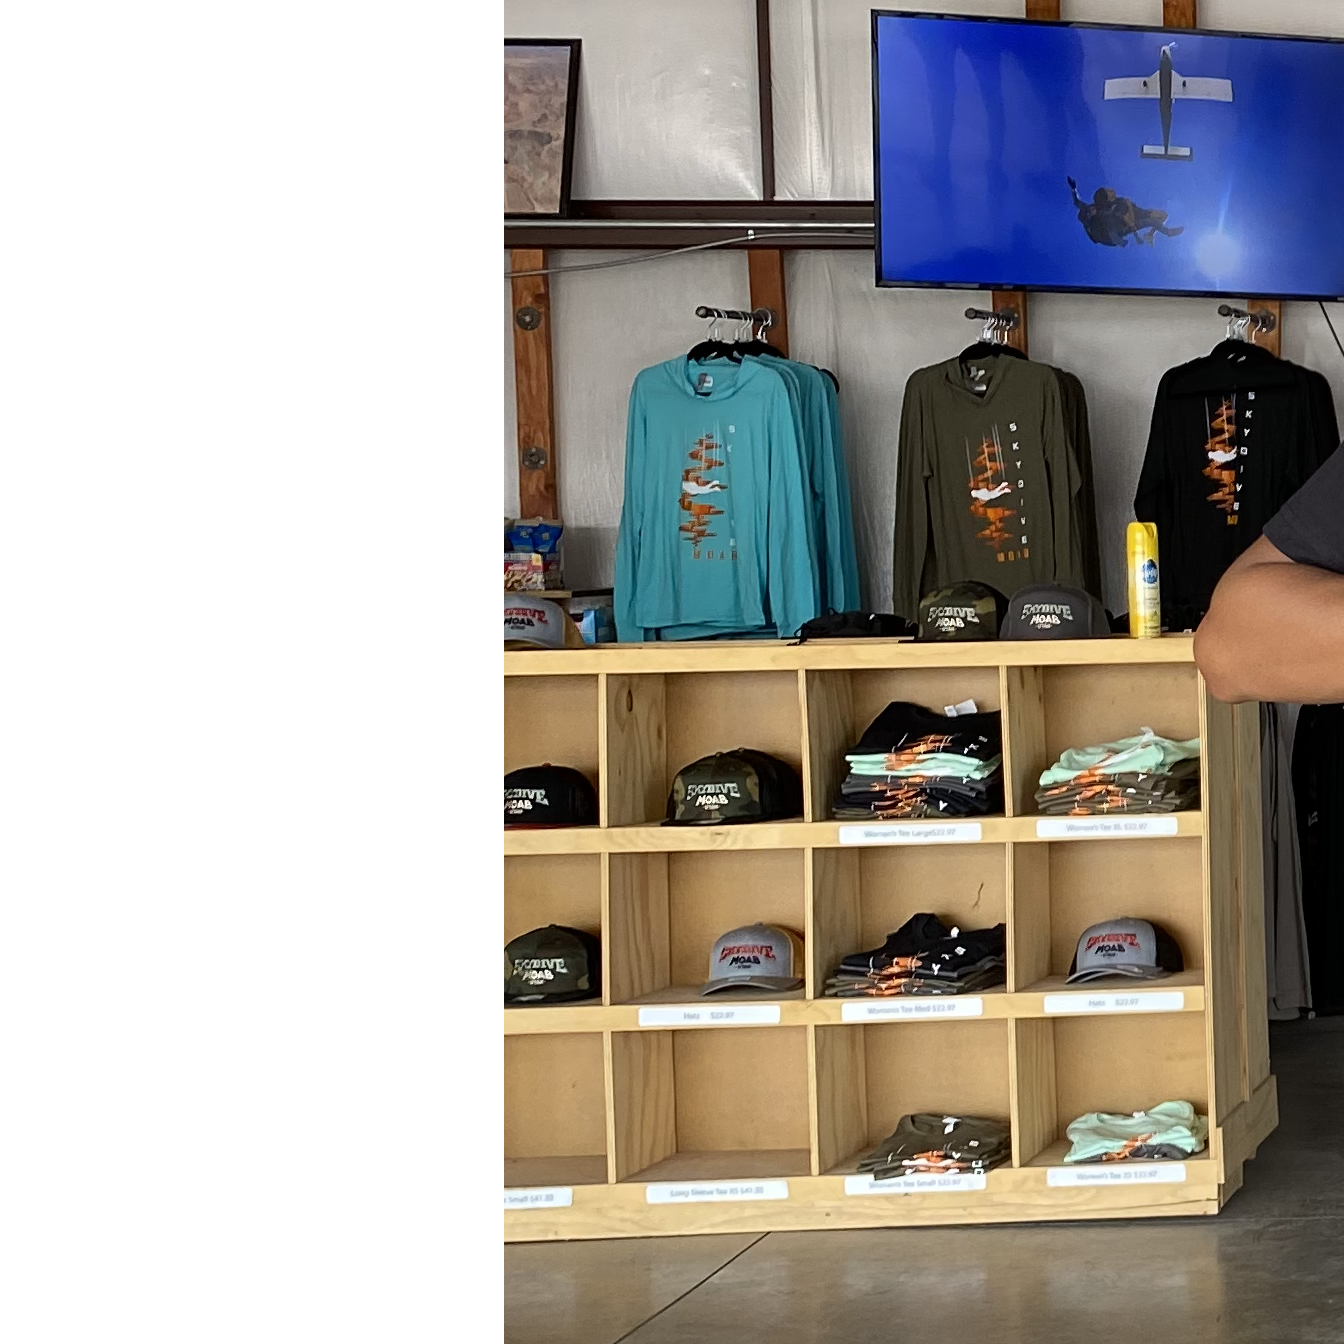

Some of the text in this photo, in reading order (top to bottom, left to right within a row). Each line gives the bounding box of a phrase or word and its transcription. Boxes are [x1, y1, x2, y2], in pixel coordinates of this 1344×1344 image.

[935, 618, 965, 628] MOAB
[1030, 614, 1061, 626] MOAB
[695, 794, 729, 806] MOAB
[1095, 944, 1125, 954] MOAB
[729, 956, 761, 966] MOAB
[522, 969, 555, 981] MOAB
